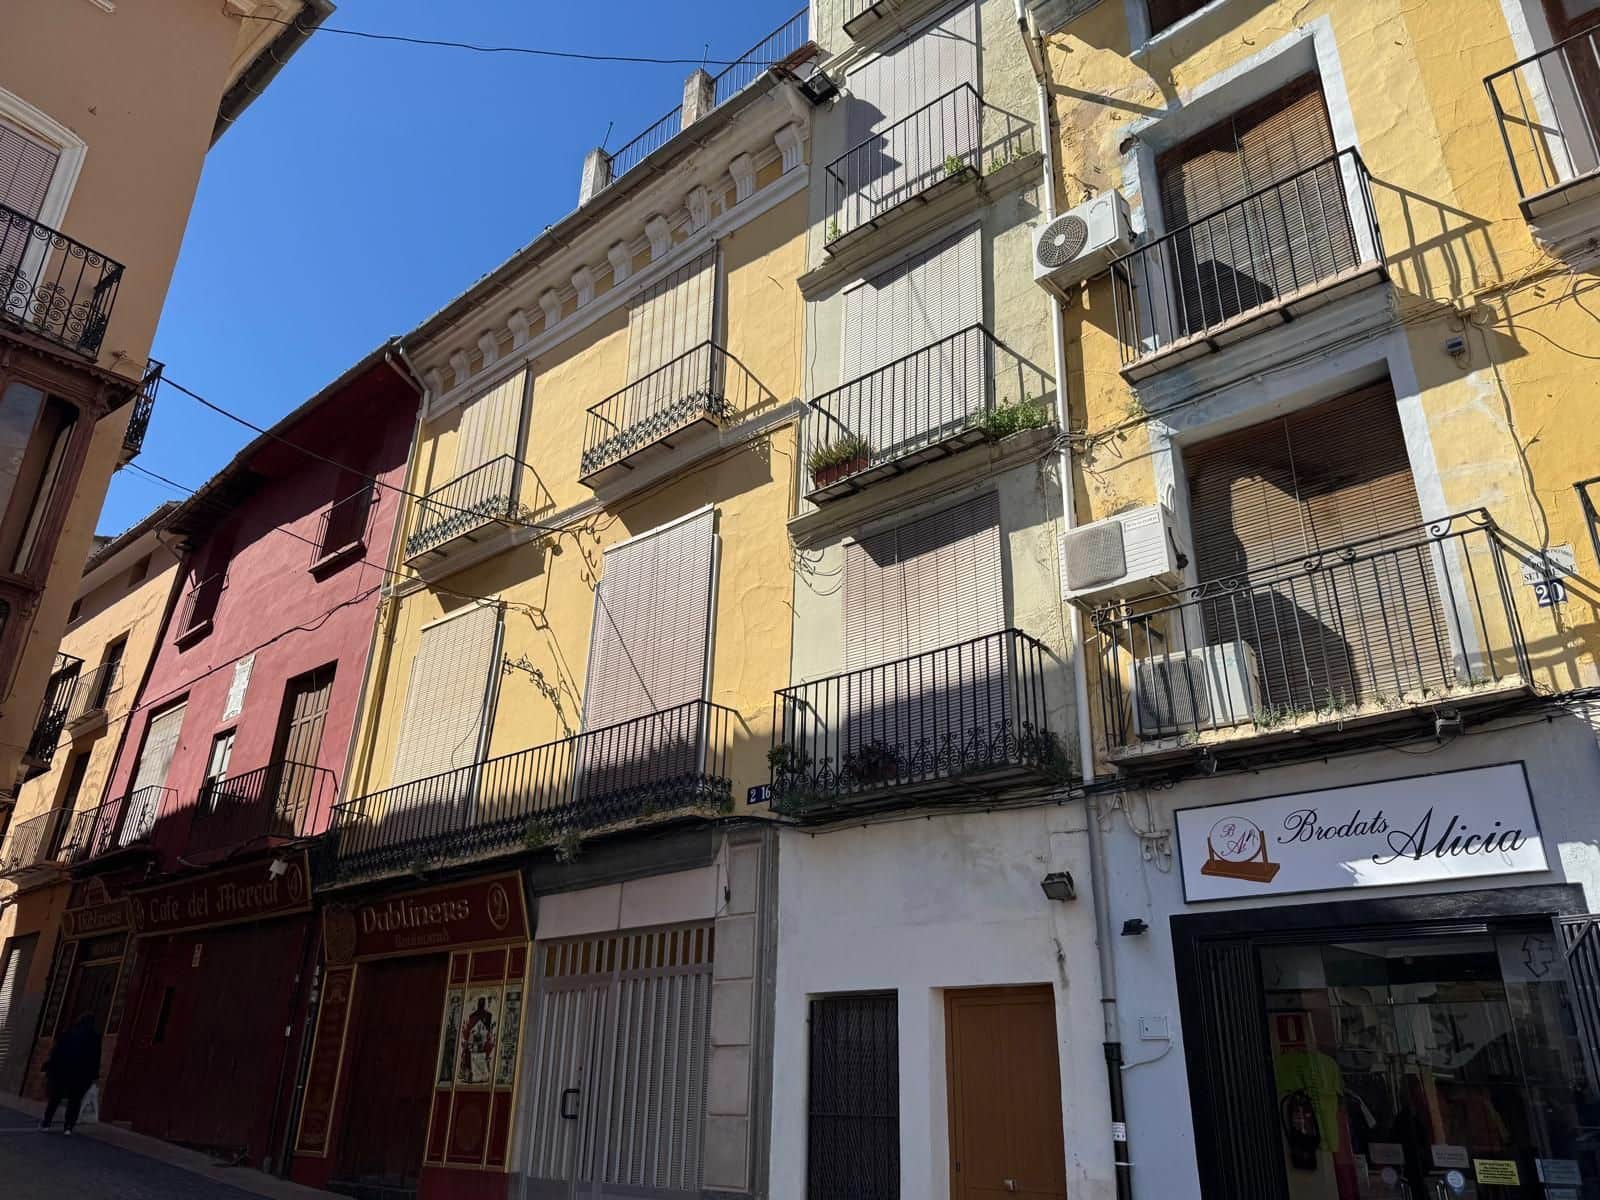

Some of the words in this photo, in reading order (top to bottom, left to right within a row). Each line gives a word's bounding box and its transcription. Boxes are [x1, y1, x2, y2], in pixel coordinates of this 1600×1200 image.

[1535, 582, 1564, 604] 20
[1277, 807, 1388, 844] Brodats
[1373, 805, 1527, 865] Alicia
[187, 888, 208, 917] del
